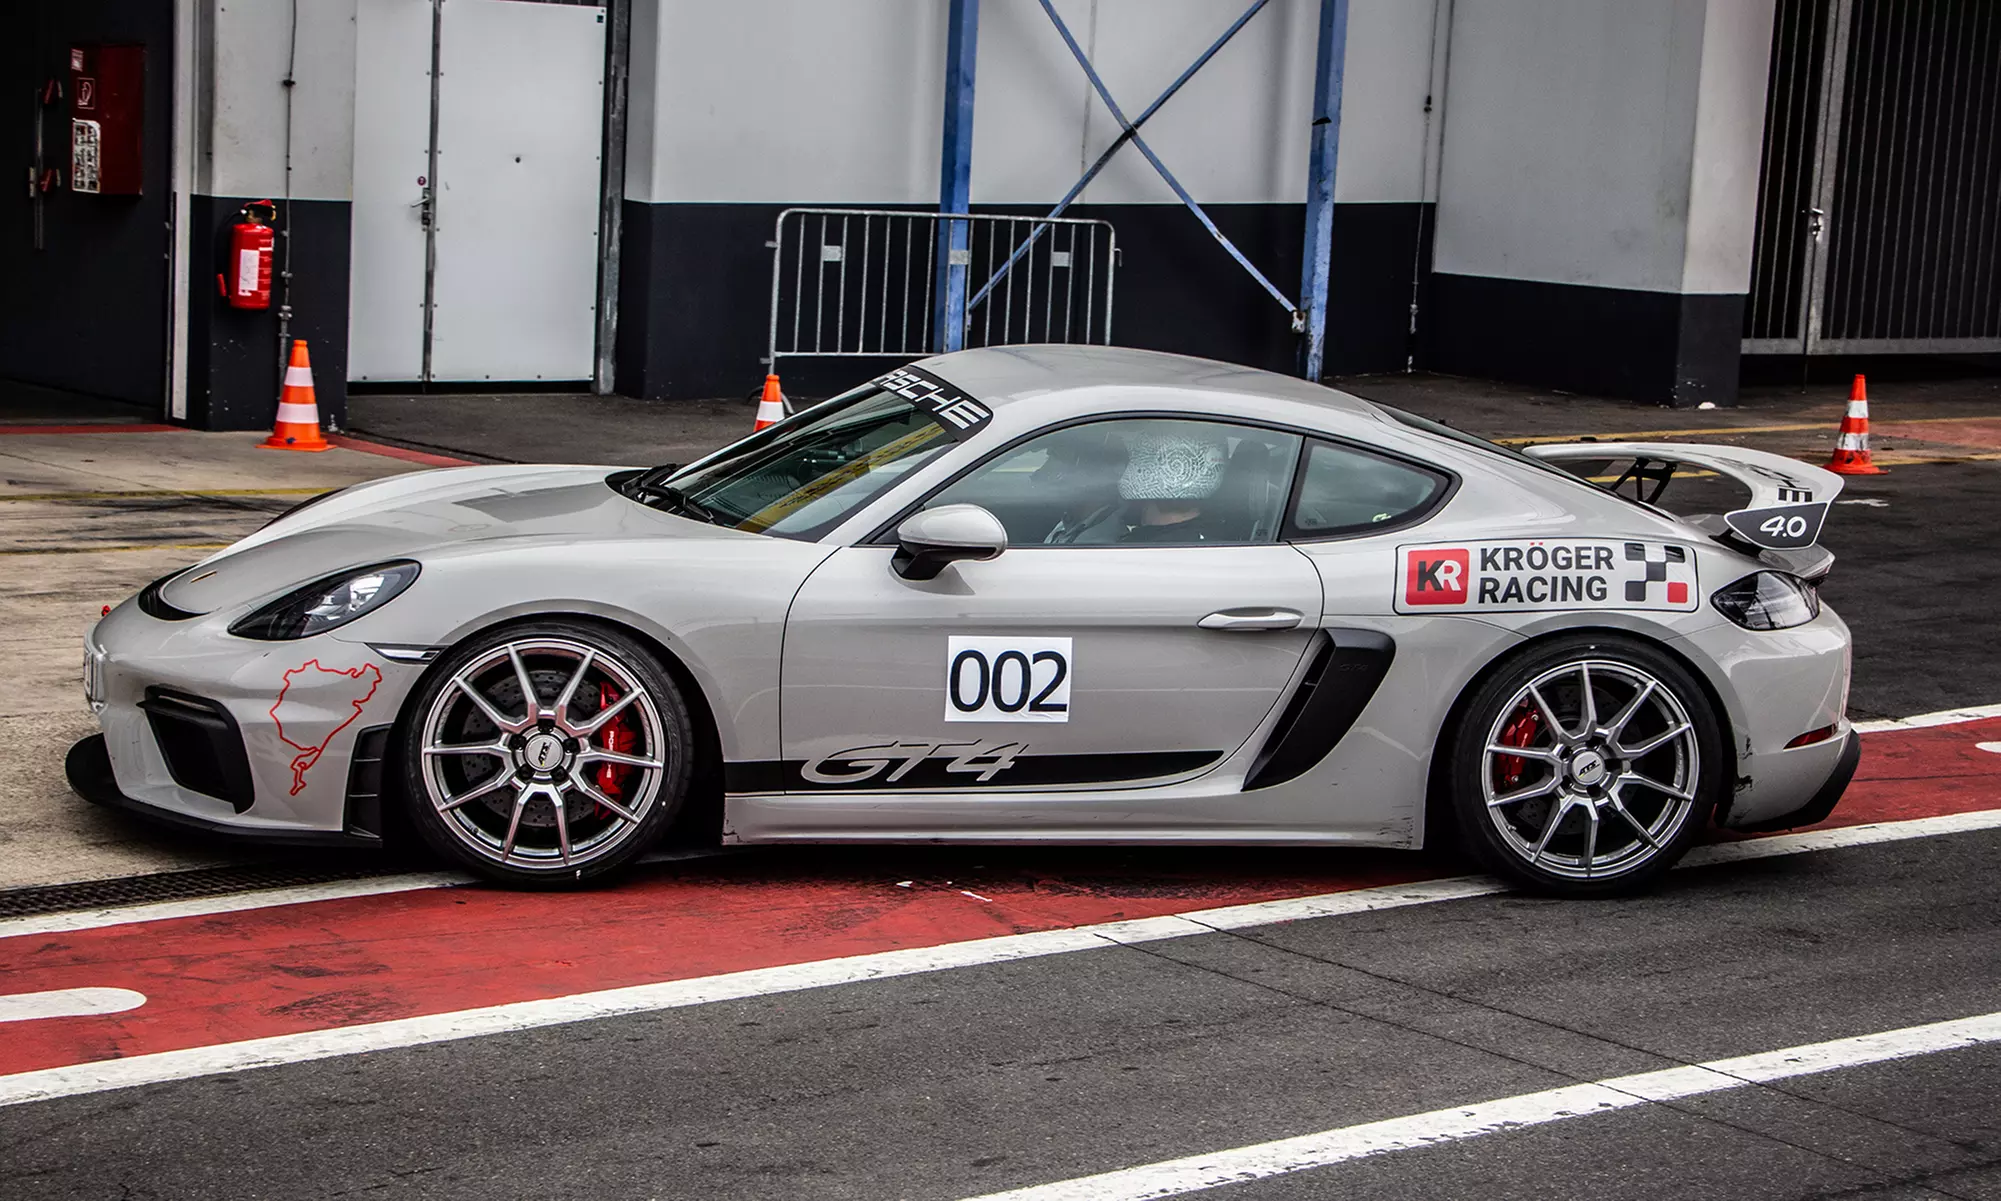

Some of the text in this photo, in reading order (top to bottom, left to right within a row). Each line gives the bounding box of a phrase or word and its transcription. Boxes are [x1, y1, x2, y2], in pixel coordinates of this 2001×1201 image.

[1760, 515, 1807, 537] 4.0
[1480, 542, 1615, 571] KRÖGER
[1417, 559, 1463, 592] KR
[1478, 575, 1608, 604] RACING
[950, 649, 1068, 713] 002
[801, 738, 1030, 784] GT4
